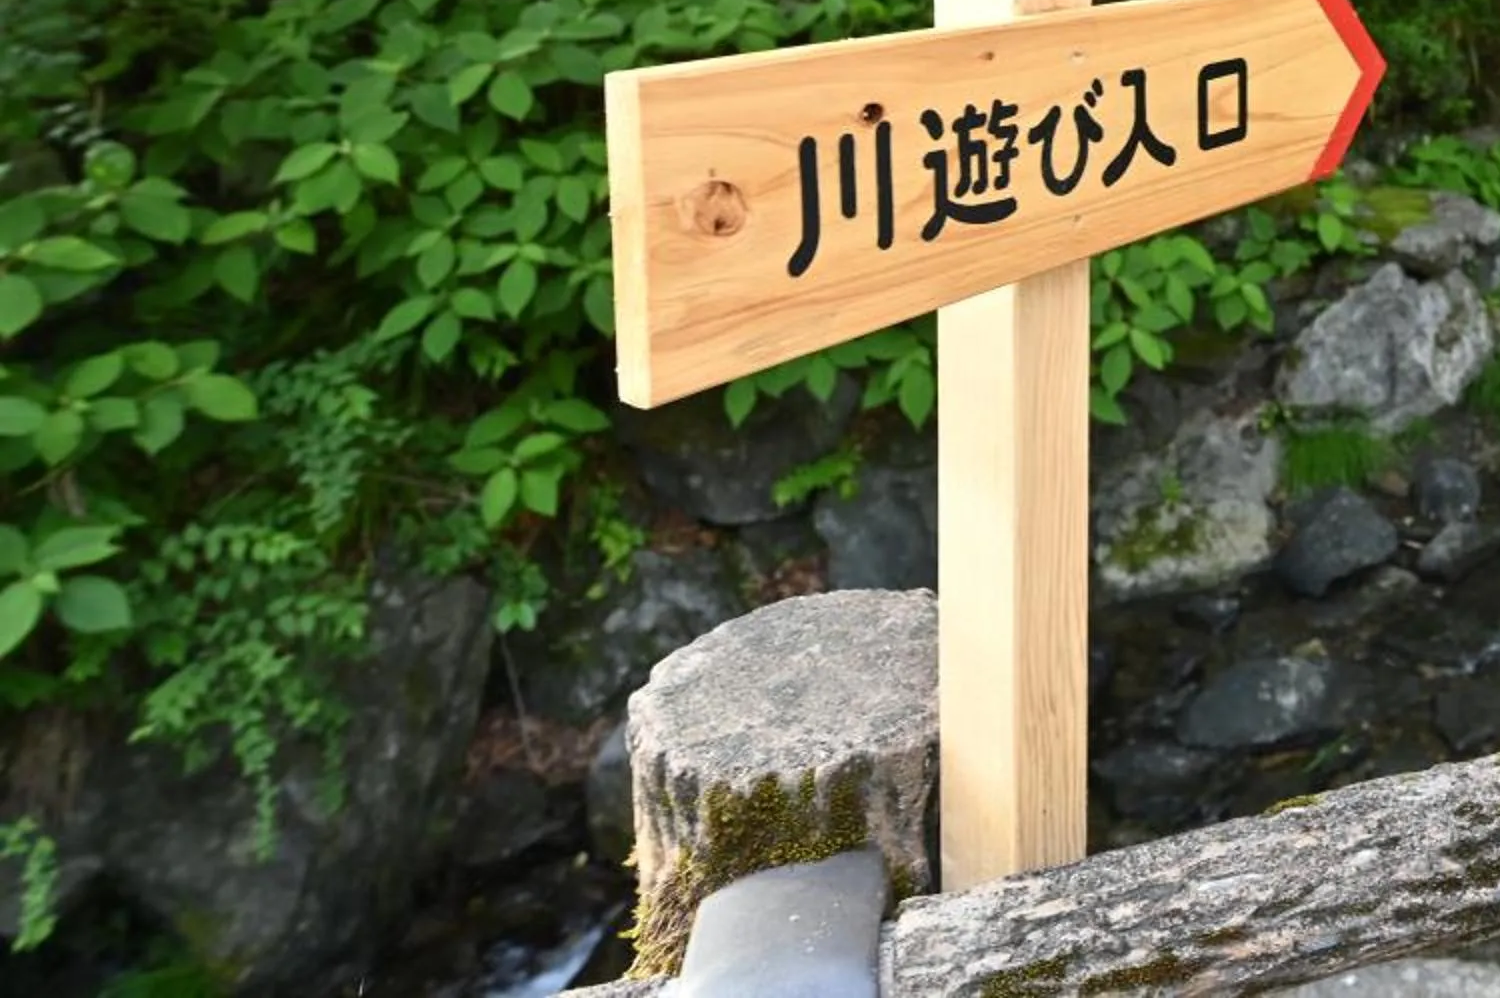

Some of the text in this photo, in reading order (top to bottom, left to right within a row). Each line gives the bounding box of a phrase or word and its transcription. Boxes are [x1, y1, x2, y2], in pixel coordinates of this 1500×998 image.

[787, 56, 1248, 277] 川遊び入口
